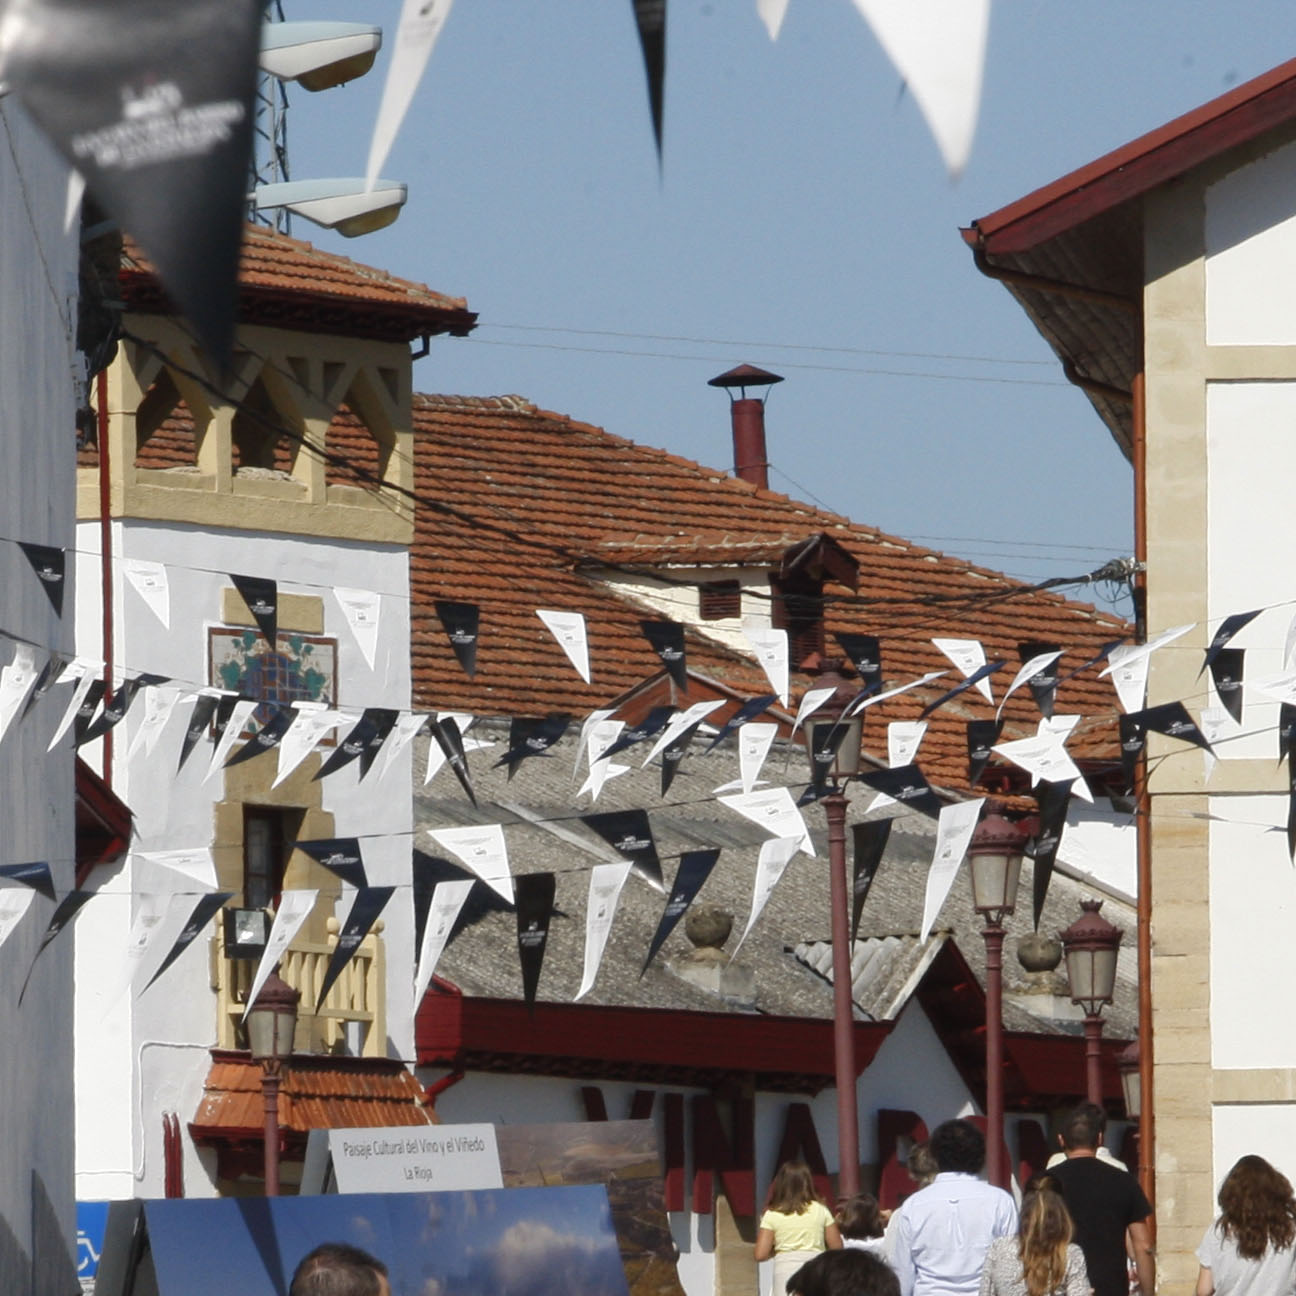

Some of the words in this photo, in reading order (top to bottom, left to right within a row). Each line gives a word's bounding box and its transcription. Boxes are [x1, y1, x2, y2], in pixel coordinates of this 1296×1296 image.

[343, 1141, 372, 1160] Paisaje
[373, 1138, 404, 1156] Cultural
[405, 1137, 418, 1154] del
[419, 1138, 439, 1153] Vino
[439, 1142, 446, 1157] y
[446, 1136, 454, 1153] el
[454, 1136, 485, 1153] Viñedo
[404, 1167, 413, 1180] La
[414, 1166, 433, 1182] Rioja
